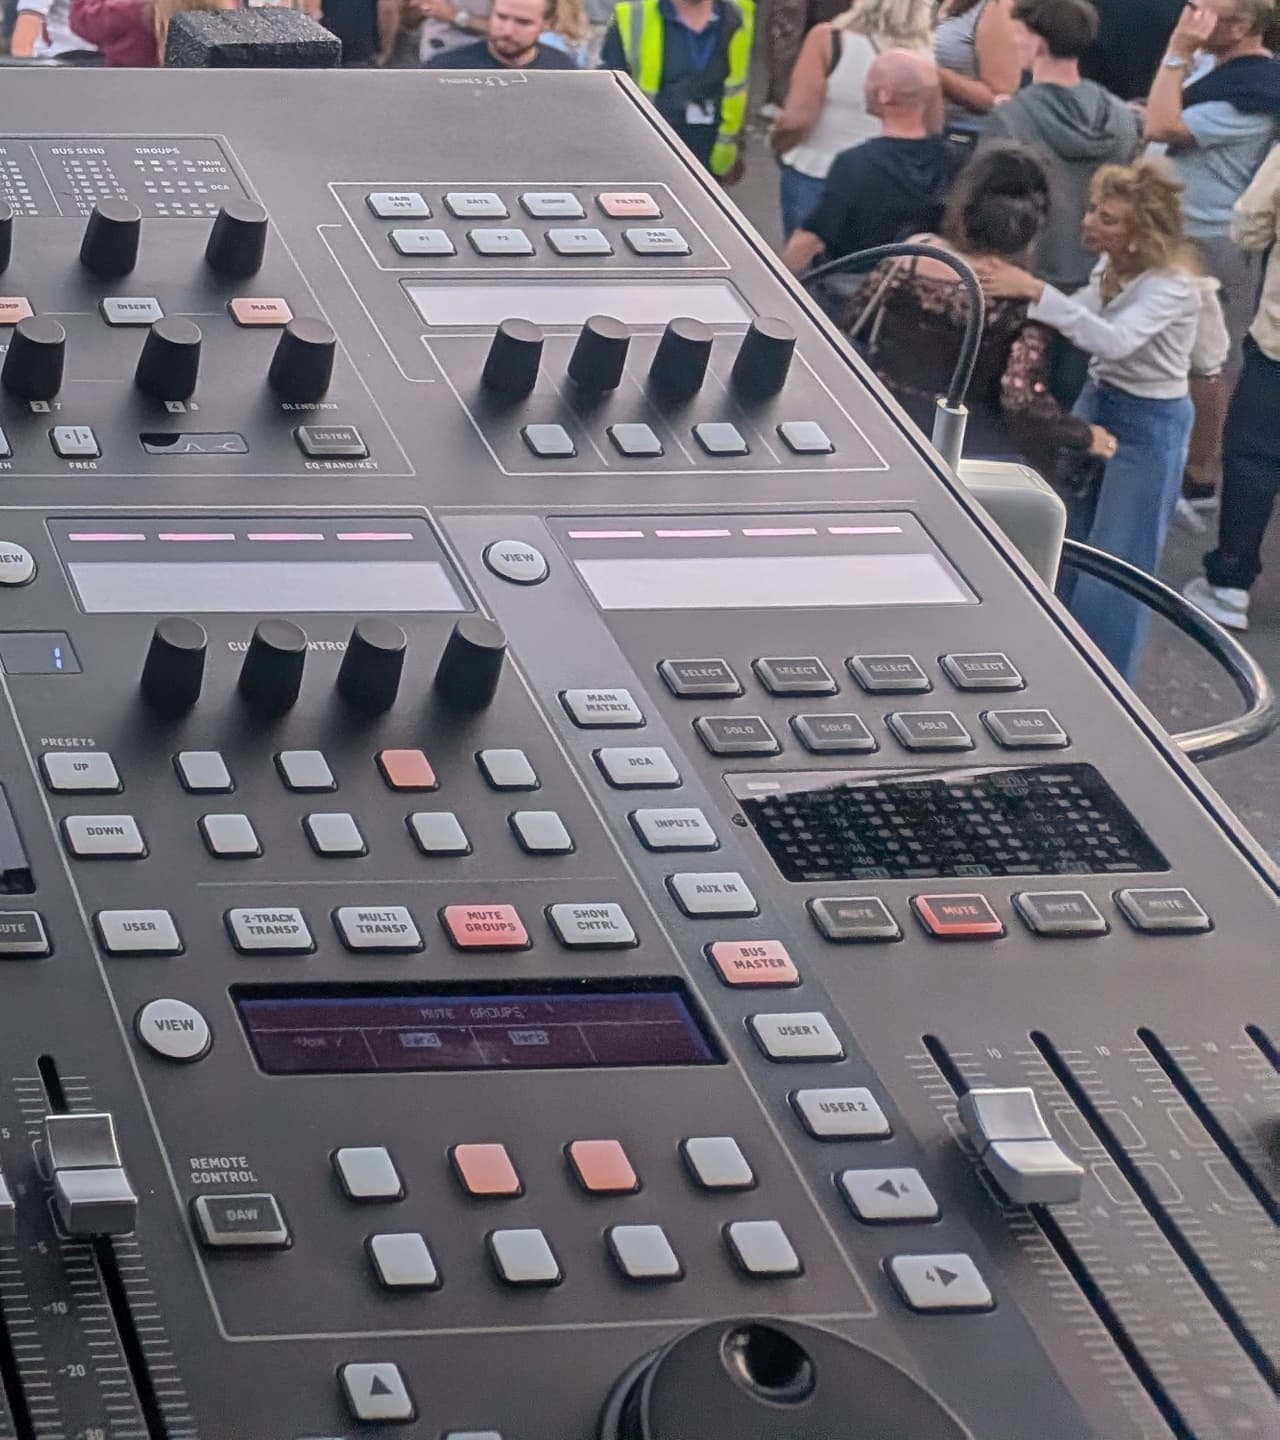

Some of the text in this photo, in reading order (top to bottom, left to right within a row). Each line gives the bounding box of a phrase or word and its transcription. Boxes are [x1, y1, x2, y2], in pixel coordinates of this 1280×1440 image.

[251, 303, 278, 311] MAIN
[281, 403, 338, 411] BLEND/MIX
[313, 432, 351, 440] LISTEN
[69, 461, 97, 470] FREQ
[304, 462, 379, 470] EQ-BAND/KEY
[501, 552, 535, 563] VIEW
[587, 694, 618, 704] MAIN
[585, 702, 631, 713] MATRIX
[40, 737, 95, 747] PRESETS
[72, 762, 90, 772] UP
[628, 757, 654, 768] DCA
[654, 818, 701, 829] INPUTS
[85, 826, 124, 836] DOWN
[466, 910, 504, 921] MUTE
[572, 909, 609, 920] SHOW
[941, 905, 979, 916] MUTE
[242, 913, 297, 924] 2-TRACK
[358, 912, 398, 922] MULTI
[122, 921, 157, 931] USER
[247, 924, 300, 936] TRANSP
[355, 923, 408, 935] TRANSP
[465, 921, 516, 934] GROUPS
[577, 919, 619, 931] CNTRL
[740, 947, 767, 958] BUS
[733, 958, 787, 969] MASTER
[154, 1017, 195, 1033] VIEW
[190, 1156, 248, 1170] REMOTE
[190, 1170, 258, 1184] CONTROL
